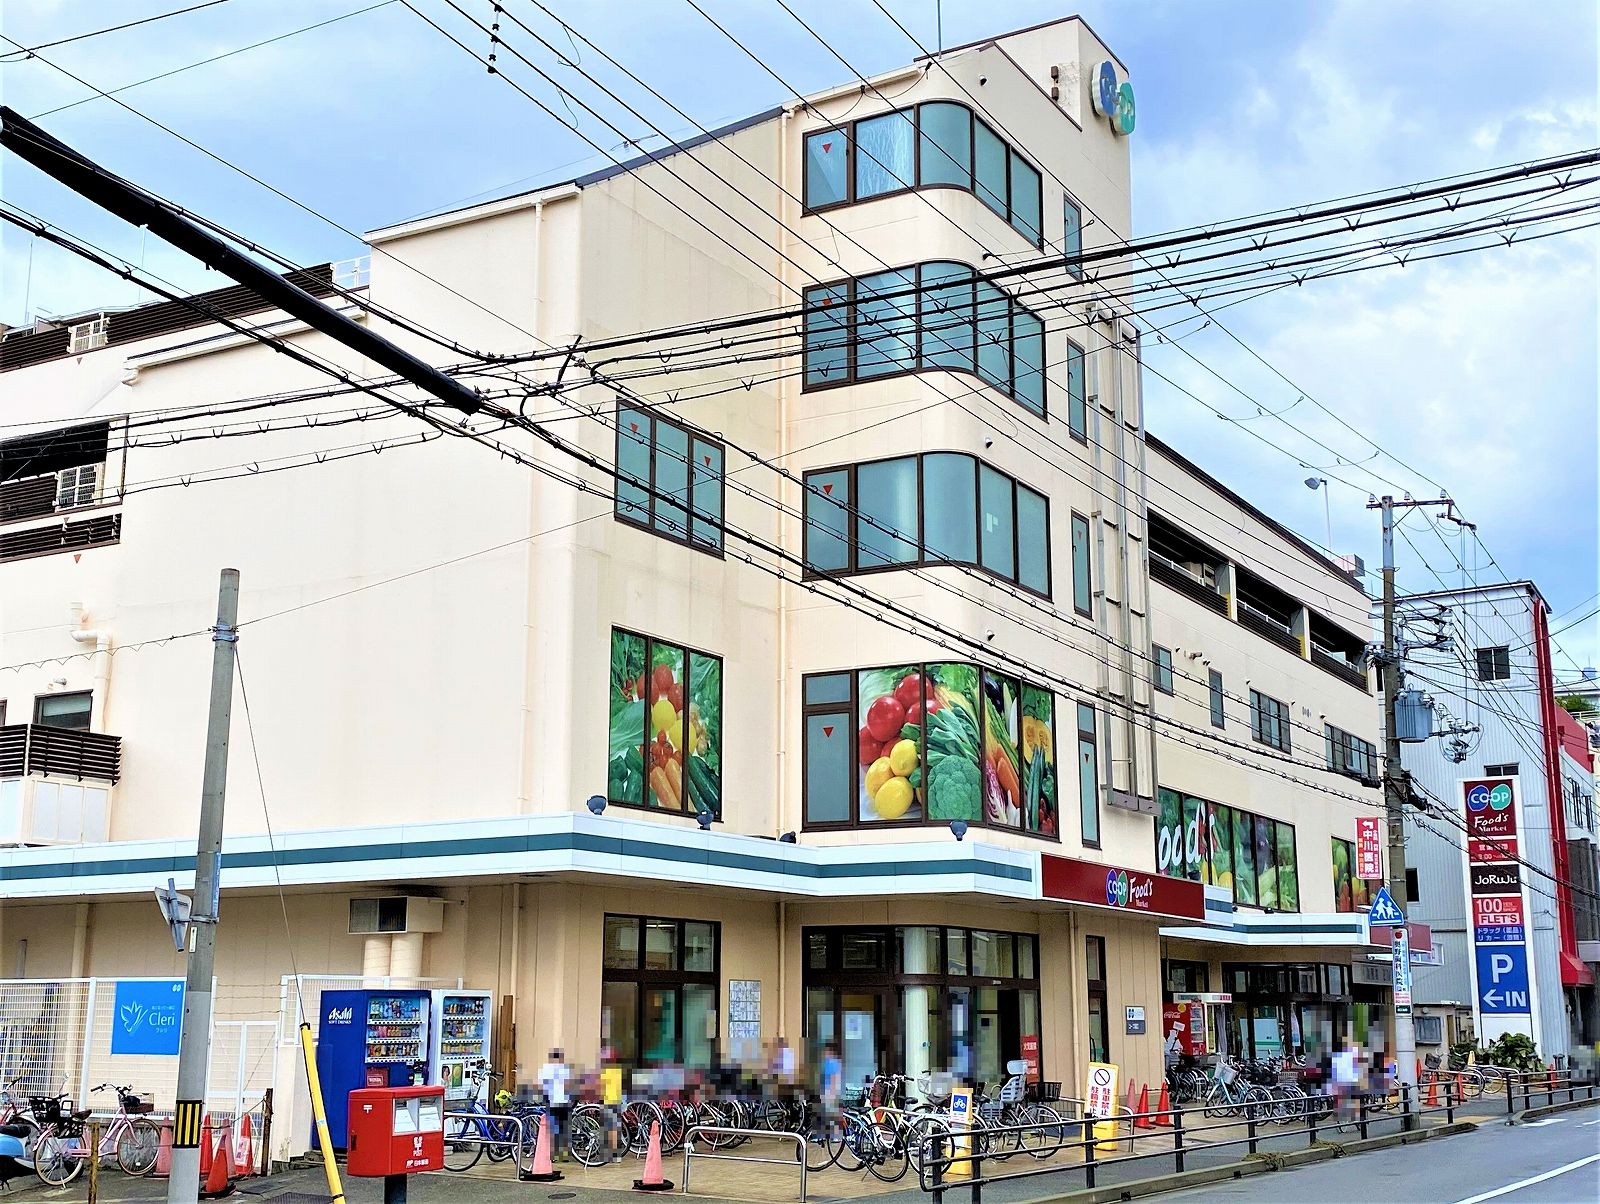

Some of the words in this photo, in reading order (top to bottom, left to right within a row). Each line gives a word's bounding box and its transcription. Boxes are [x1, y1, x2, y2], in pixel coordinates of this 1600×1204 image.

[1474, 813, 1509, 828] Food's
[1362, 829, 1375, 873] 中川医院
[1130, 877, 1152, 902] Food's
[1476, 899, 1503, 913] 100
[1481, 914, 1517, 924] FLET'S
[1491, 954, 1514, 983] P
[1505, 991, 1527, 1007] IN
[149, 1012, 175, 1026] Cleri
[328, 1007, 353, 1020] Asahi
